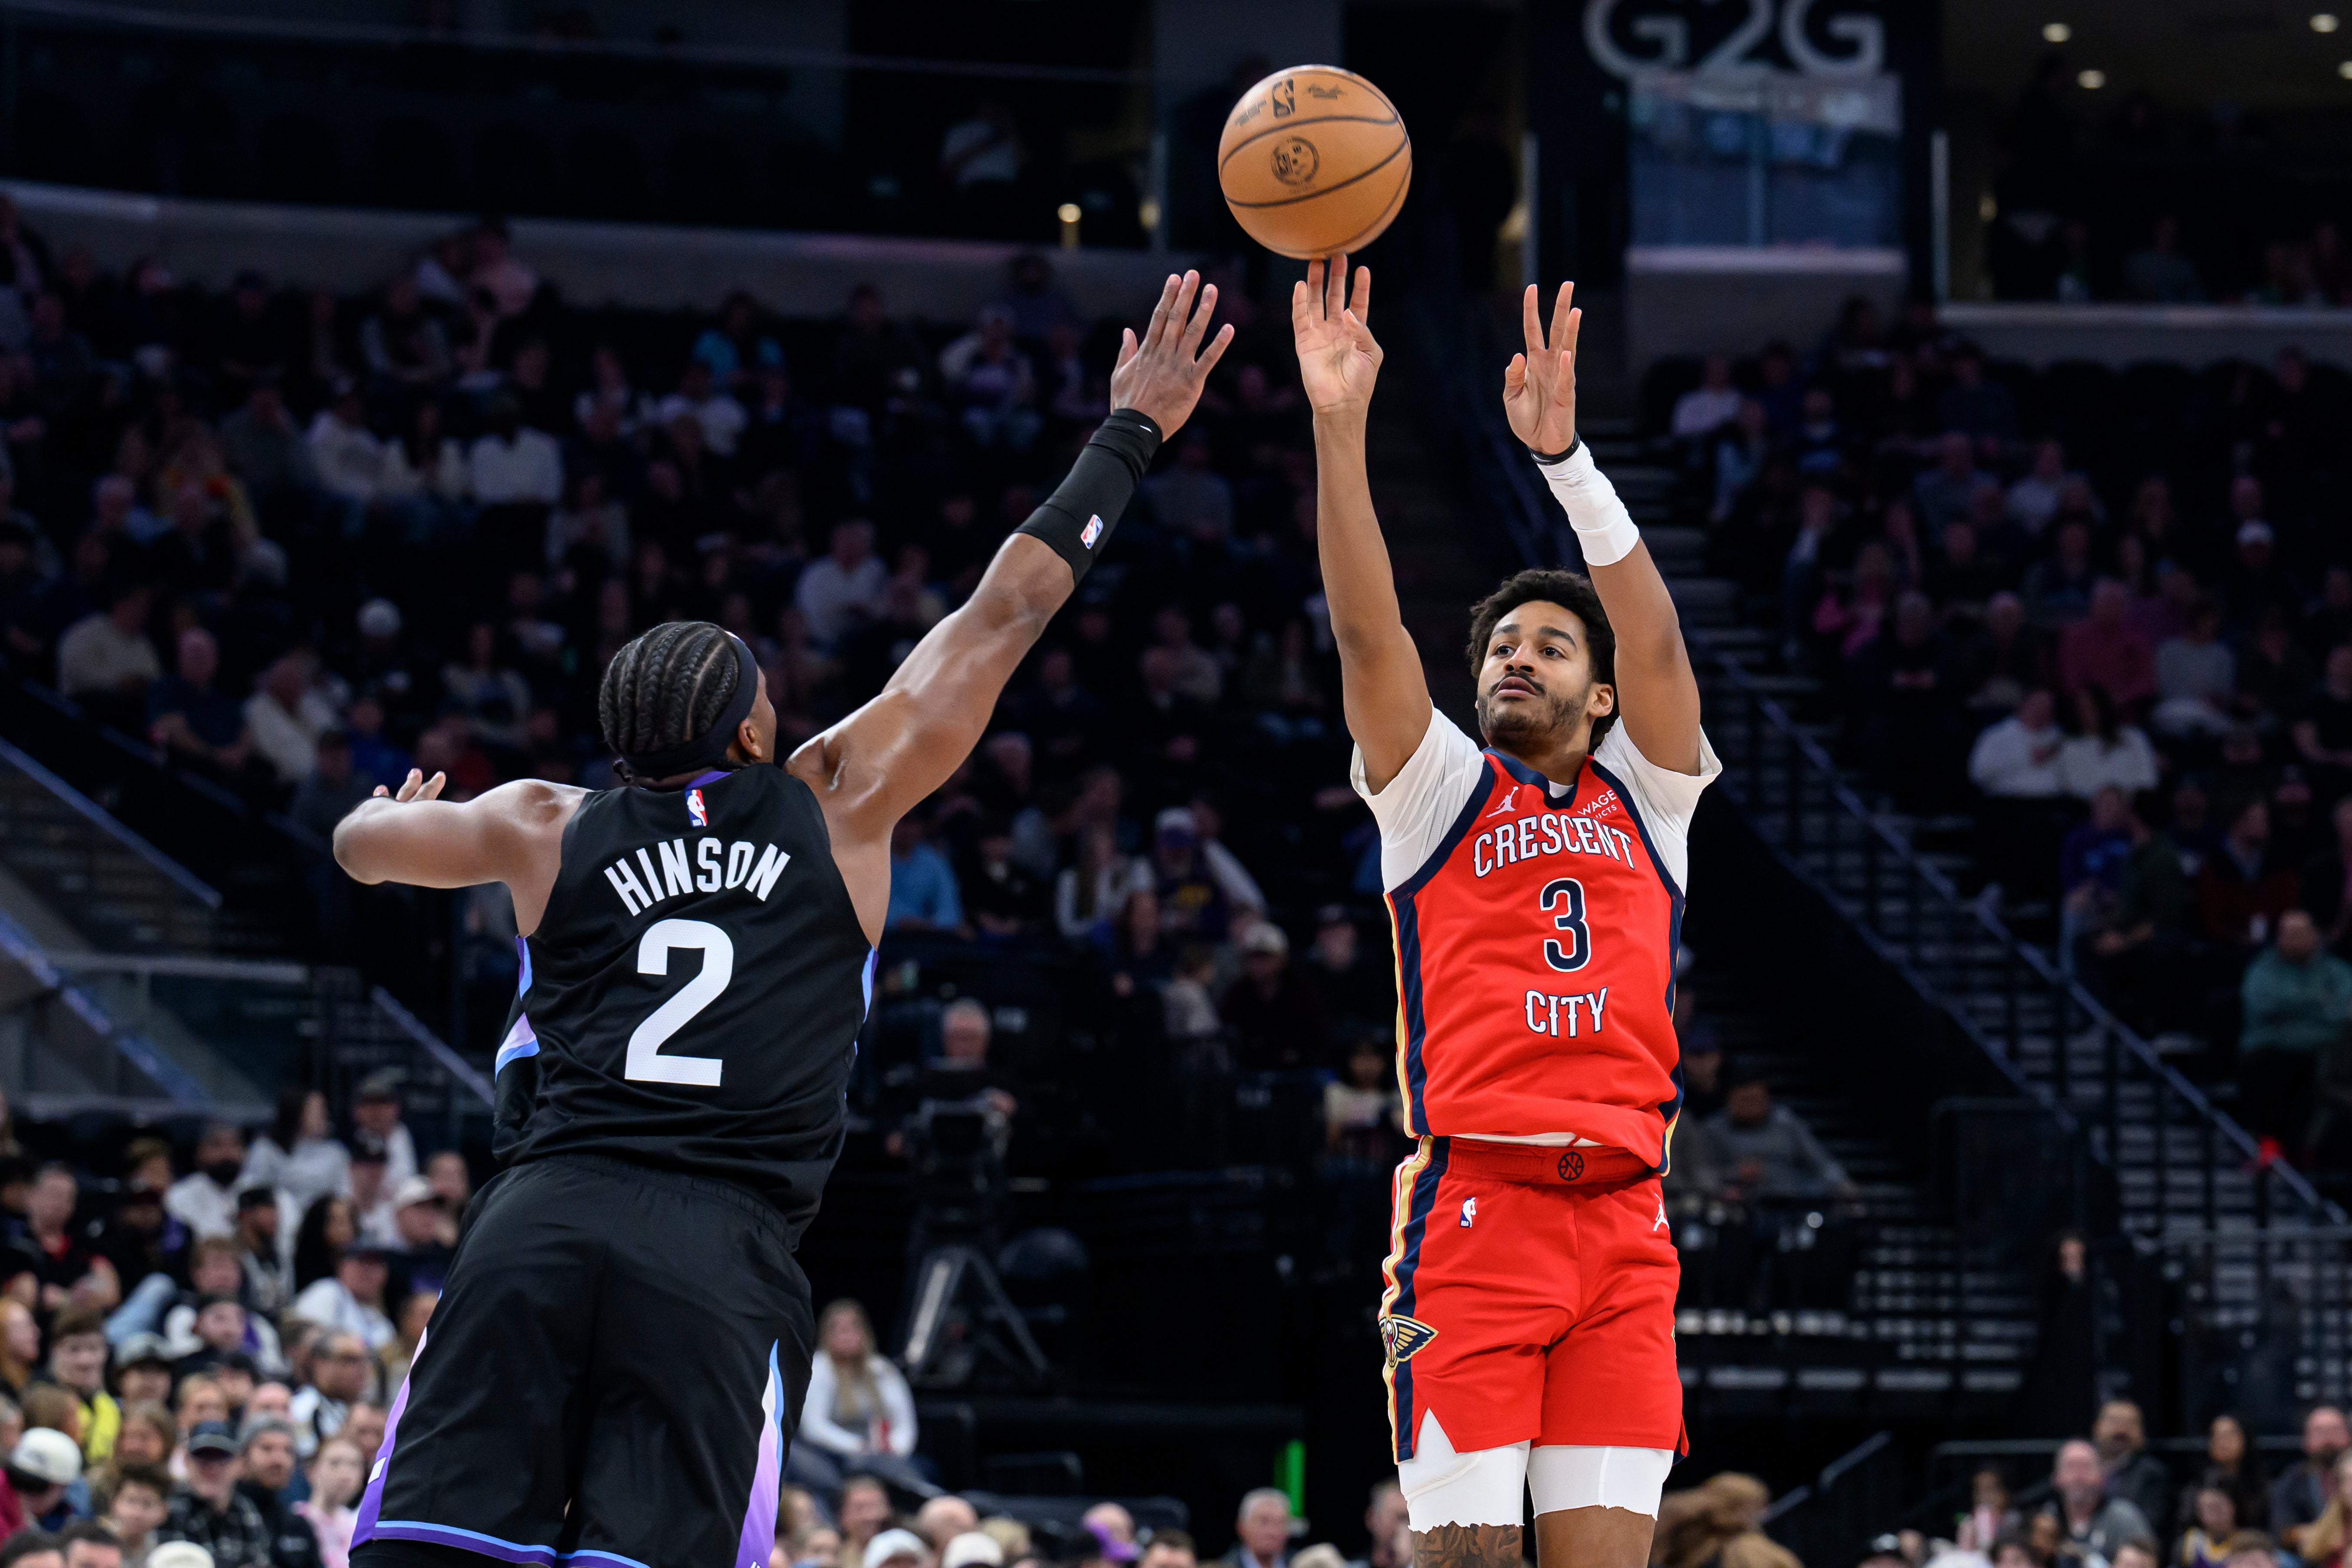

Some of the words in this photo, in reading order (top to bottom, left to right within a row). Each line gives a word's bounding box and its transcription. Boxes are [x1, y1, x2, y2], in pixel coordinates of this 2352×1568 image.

[604, 837, 791, 917] HINSON
[1474, 813, 1635, 878] CRESCENT
[1539, 878, 1591, 972] 3
[624, 918, 734, 1086] 2
[1525, 987, 1608, 1038] CITY
